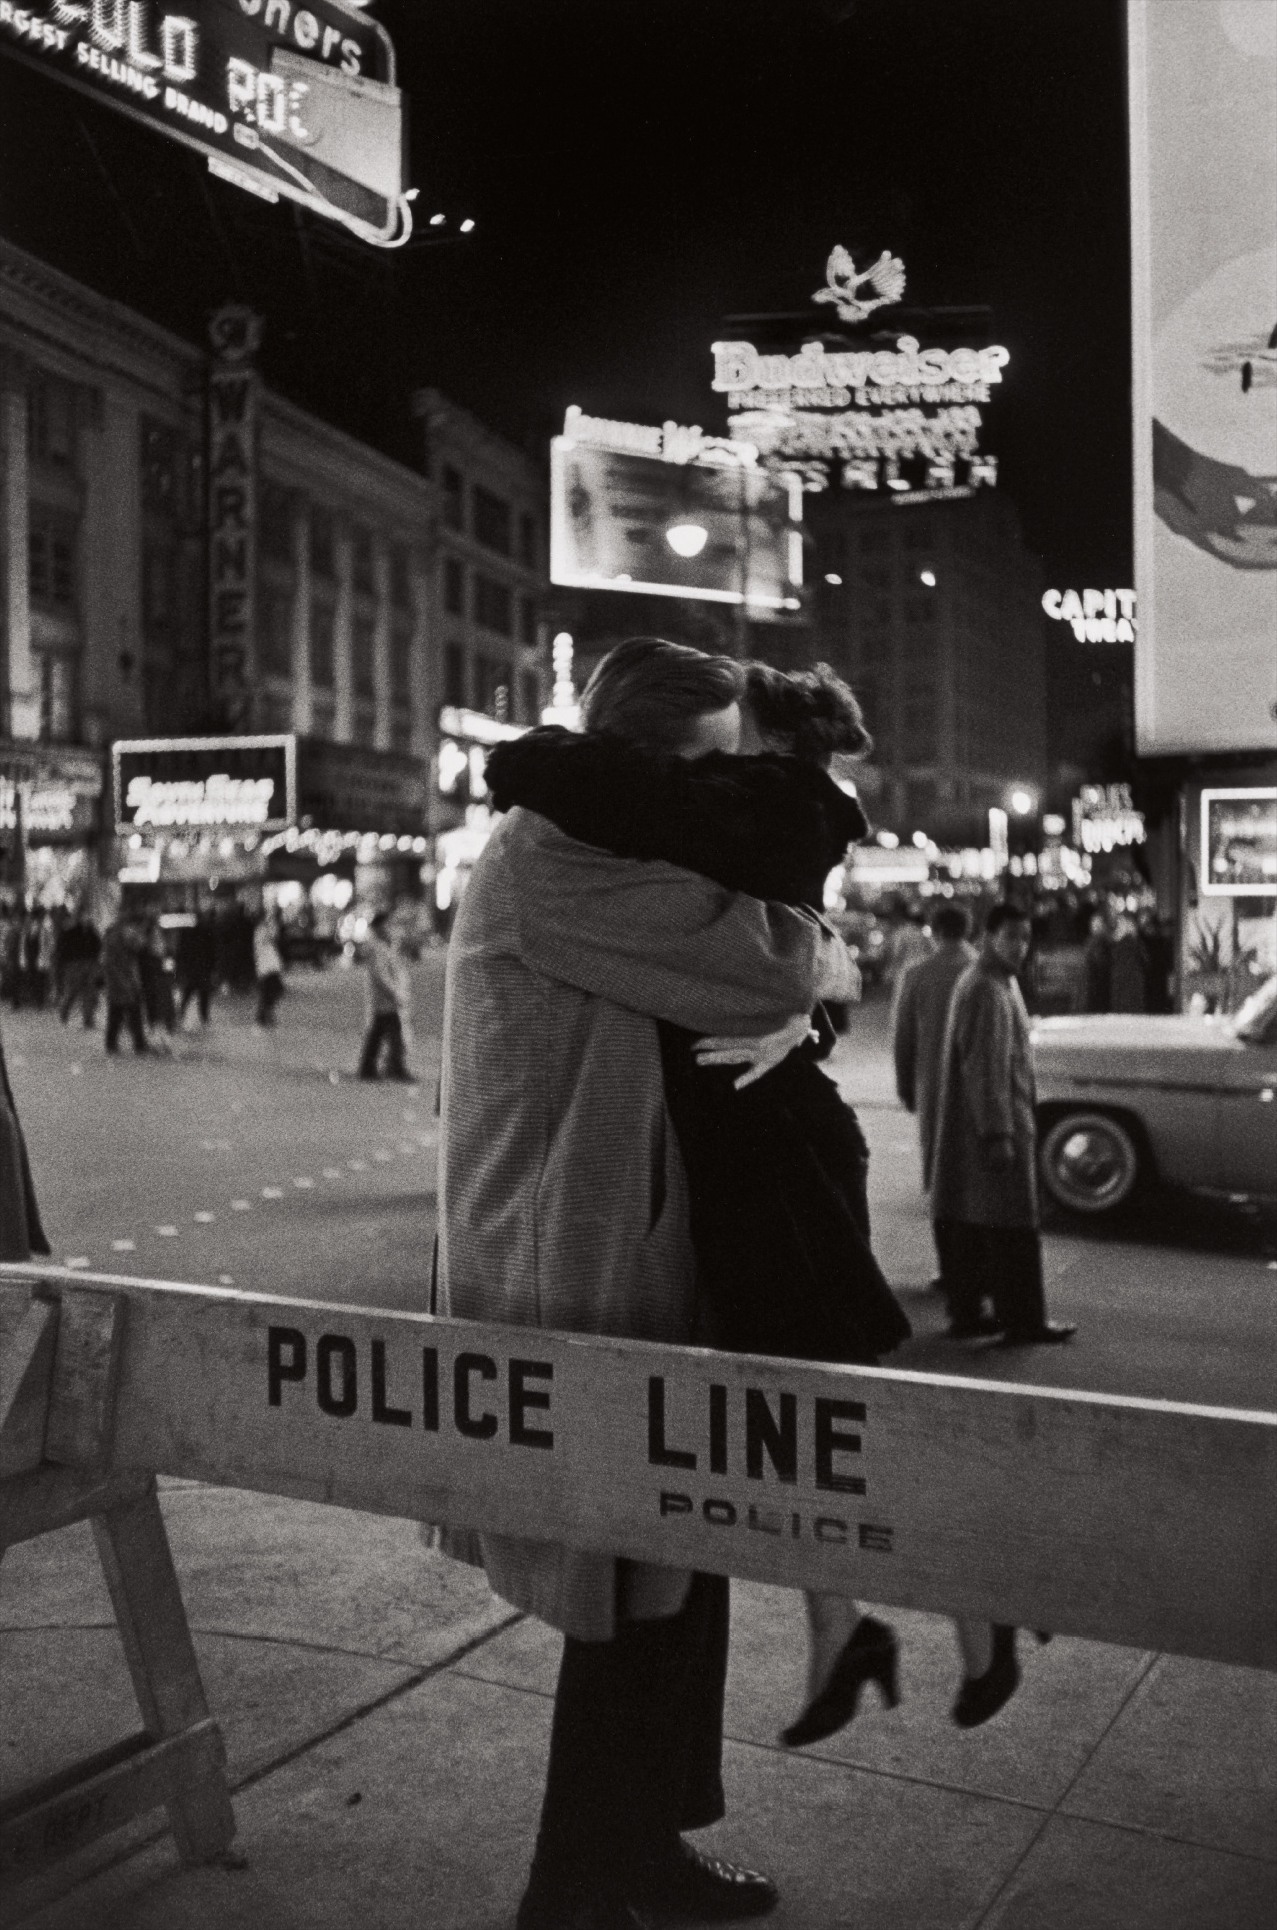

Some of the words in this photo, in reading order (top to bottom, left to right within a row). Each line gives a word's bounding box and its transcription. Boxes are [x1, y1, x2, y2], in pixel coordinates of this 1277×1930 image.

[77, 41, 160, 99] SELLING
[164, 87, 228, 134] BRAND
[711, 334, 1010, 392] Budweiser
[268, 1326, 554, 1449] POLICE
[648, 1376, 867, 1495] LINE
[660, 1493, 895, 1552] POLICE
